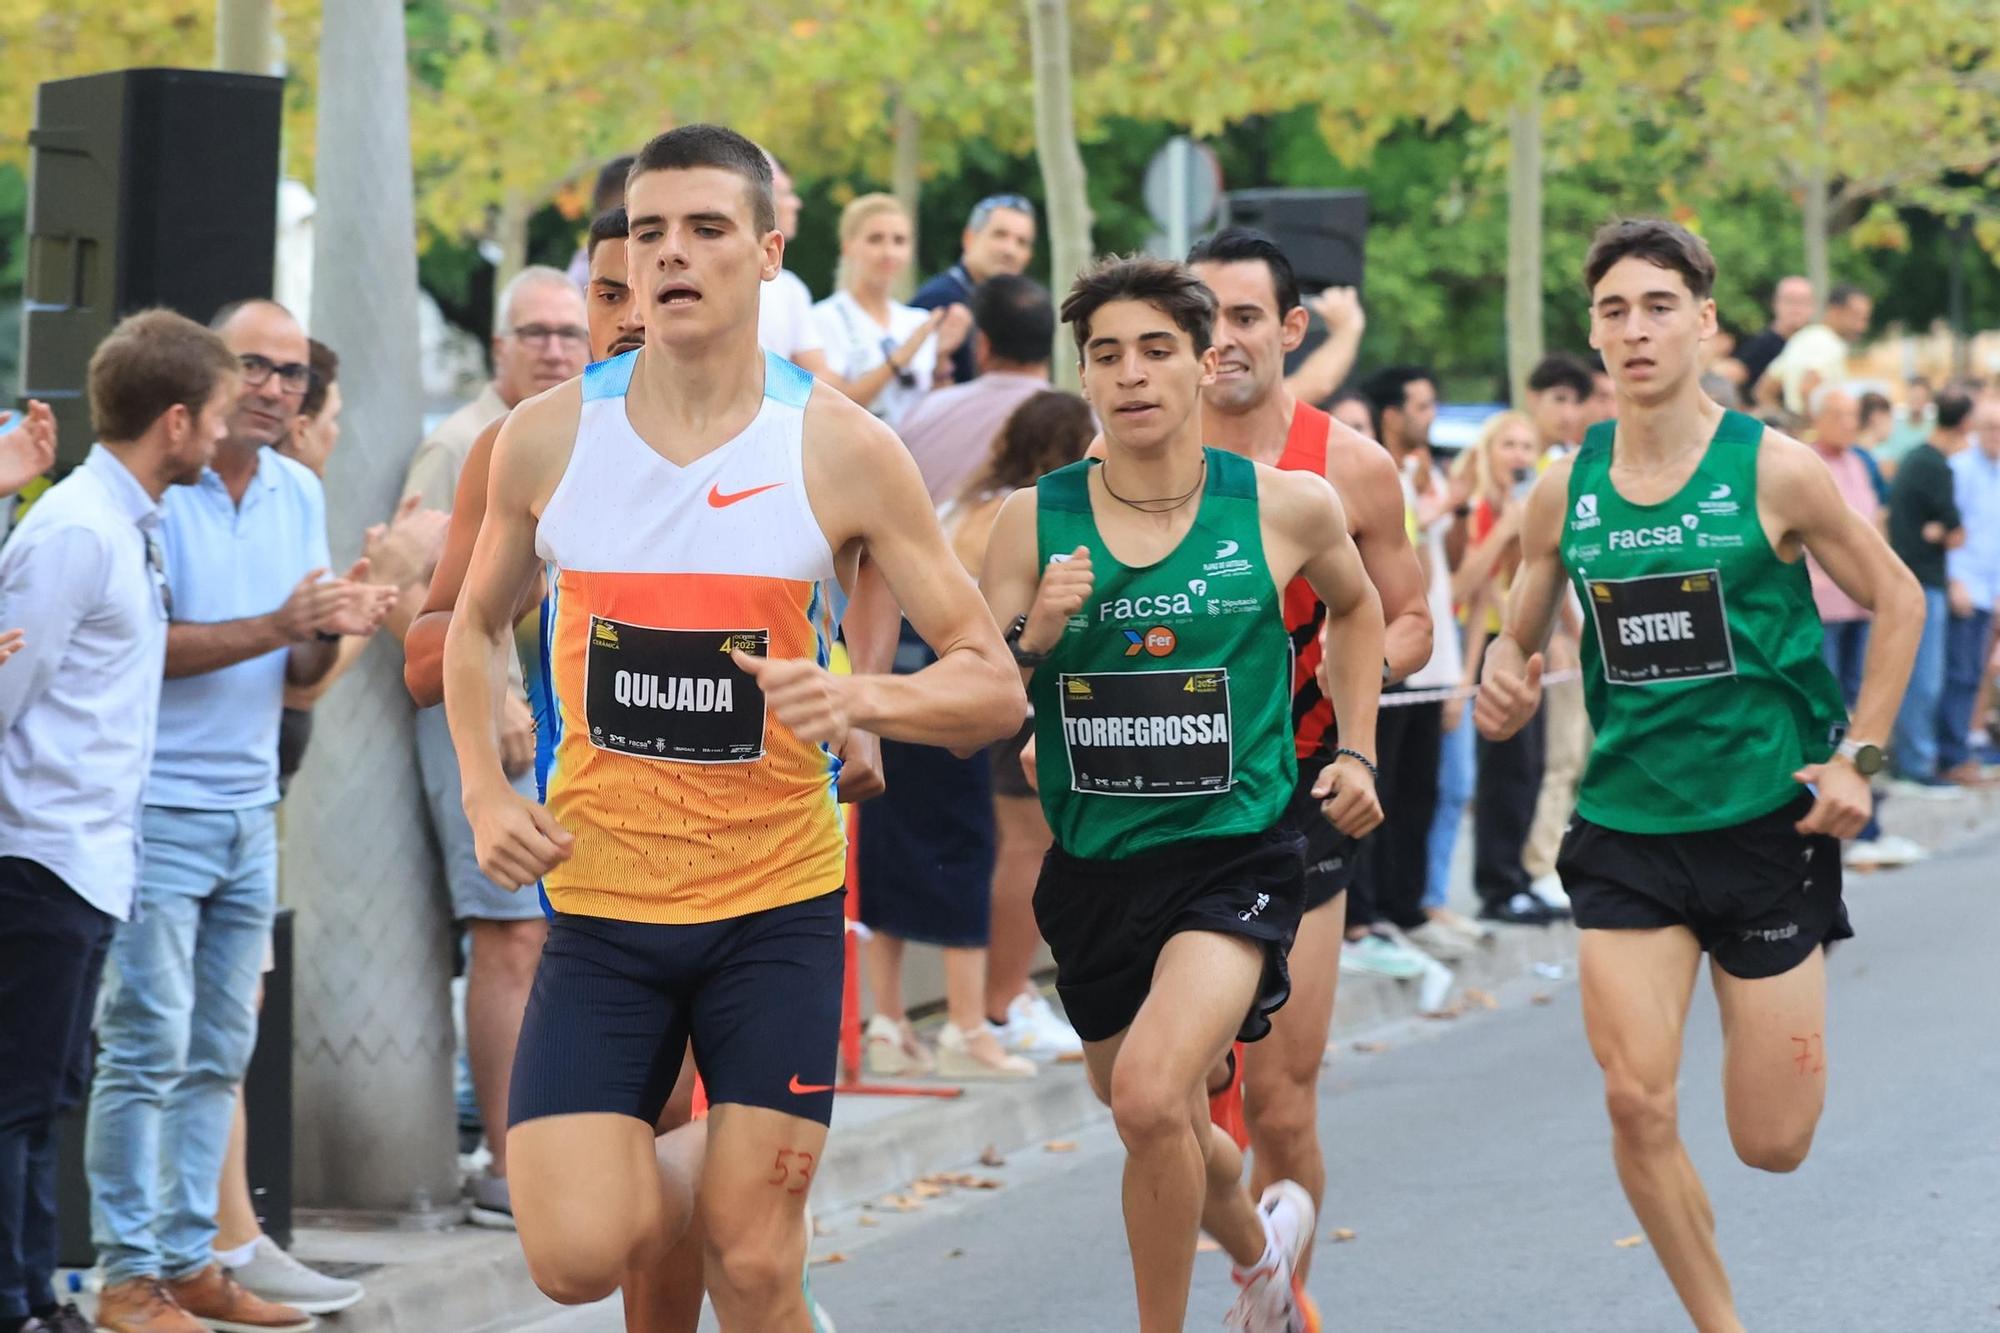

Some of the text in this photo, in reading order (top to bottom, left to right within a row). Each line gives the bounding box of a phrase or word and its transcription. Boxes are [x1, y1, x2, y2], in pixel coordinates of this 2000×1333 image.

[1609, 525, 1683, 551] Facsa
[1099, 593, 1192, 622] Facsa
[1147, 633, 1172, 648] Fer
[1617, 611, 1695, 646] ESTEVE
[719, 636, 732, 654] 4
[735, 641, 756, 649] 2025
[614, 669, 733, 713] QUIJADA
[1183, 676, 1195, 693] 4
[1065, 713, 1228, 747] TORREGROSSA
[768, 1149, 813, 1195] 53
